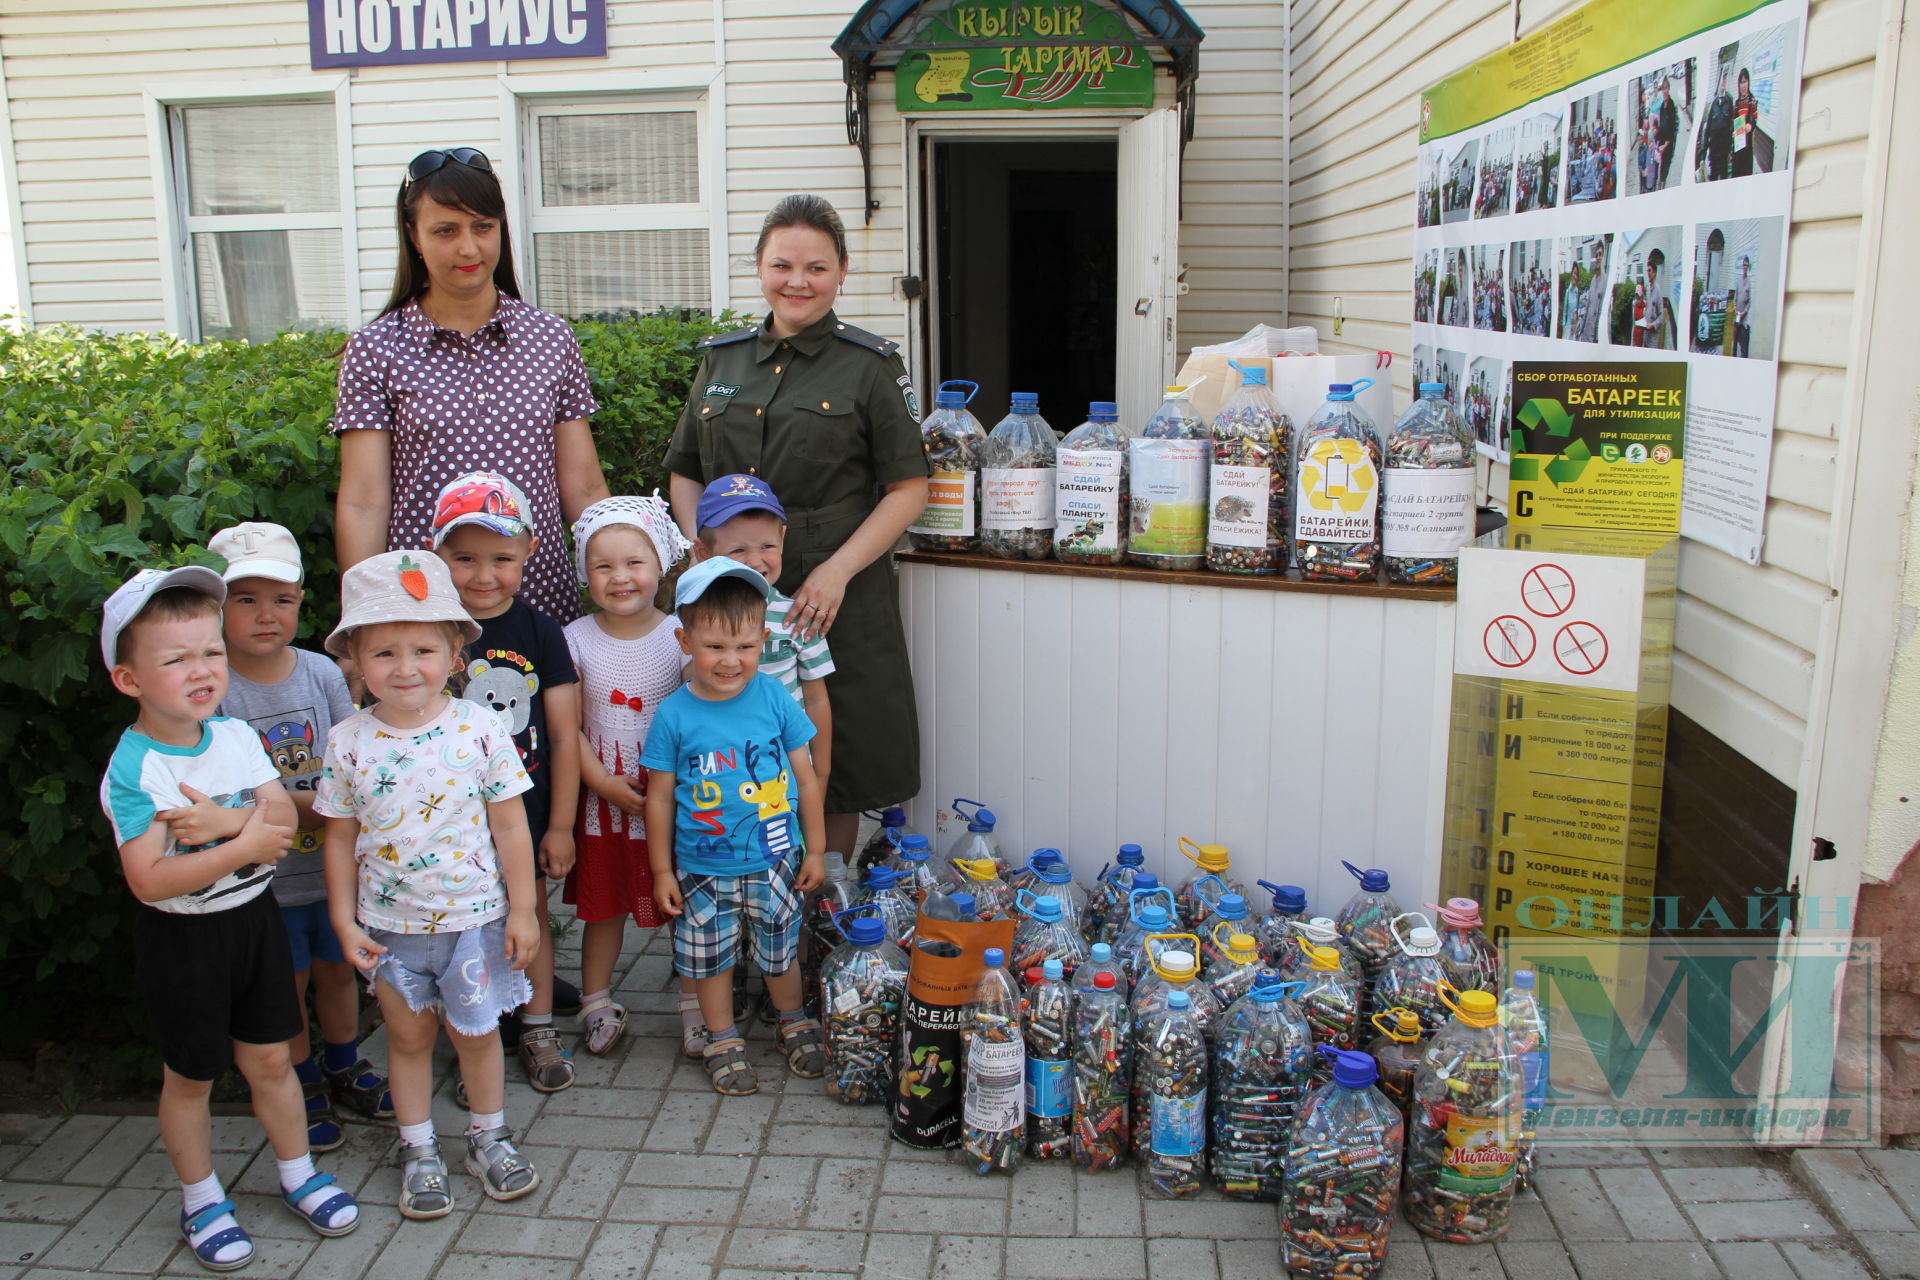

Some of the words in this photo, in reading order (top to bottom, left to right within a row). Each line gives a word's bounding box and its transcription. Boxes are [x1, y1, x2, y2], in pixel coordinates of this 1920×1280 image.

[324, 0, 587, 54] НОТАРИУС
[1517, 373, 1546, 382] СБОР
[1549, 373, 1638, 384] ОТРАБОТАННЫХ
[1567, 388, 1681, 406] БАТАРЕЕК
[1583, 409, 1606, 419] ДЛЯ
[1610, 410, 1681, 420] УТИЛИЗАЦИИ
[1620, 433, 1673, 441] ПОДДЕРЖКЕ
[1074, 475, 1101, 484] СДАЙ
[1224, 470, 1245, 479] СДАЙ
[1060, 483, 1115, 493] БАТАРЕЙКУ
[1563, 487, 1585, 495] СДАЙ
[1588, 488, 1634, 497] БАТАРЕЙКУ
[1637, 490, 1679, 499] СЕГОДНЯ!
[1069, 501, 1102, 509] СПАСИ
[1516, 490, 1534, 517] С
[1428, 510, 1434, 518] 2
[1300, 516, 1372, 528] БАТАРЕЙКИ,
[1300, 526, 1371, 539] СДАВАЙТЕСЬ!
[486, 649, 534, 672] FUNNY
[1537, 710, 1558, 719] Если
[1596, 742, 1612, 750] 000
[1583, 752, 1598, 760] 000
[689, 748, 736, 777] FUN
[1532, 790, 1554, 800] Если
[1556, 794, 1593, 805] соберем
[1524, 813, 1576, 827] загрязнение
[1579, 820, 1589, 829] 12
[1591, 822, 1606, 830] 000
[1561, 830, 1575, 839] 180
[1577, 832, 1592, 841] 000
[1526, 861, 1589, 878] ХОРОШЕЕ
[1527, 879, 1548, 887] Если
[1550, 883, 1587, 894] соберем
[916, 1115, 958, 1137] DURACELL
